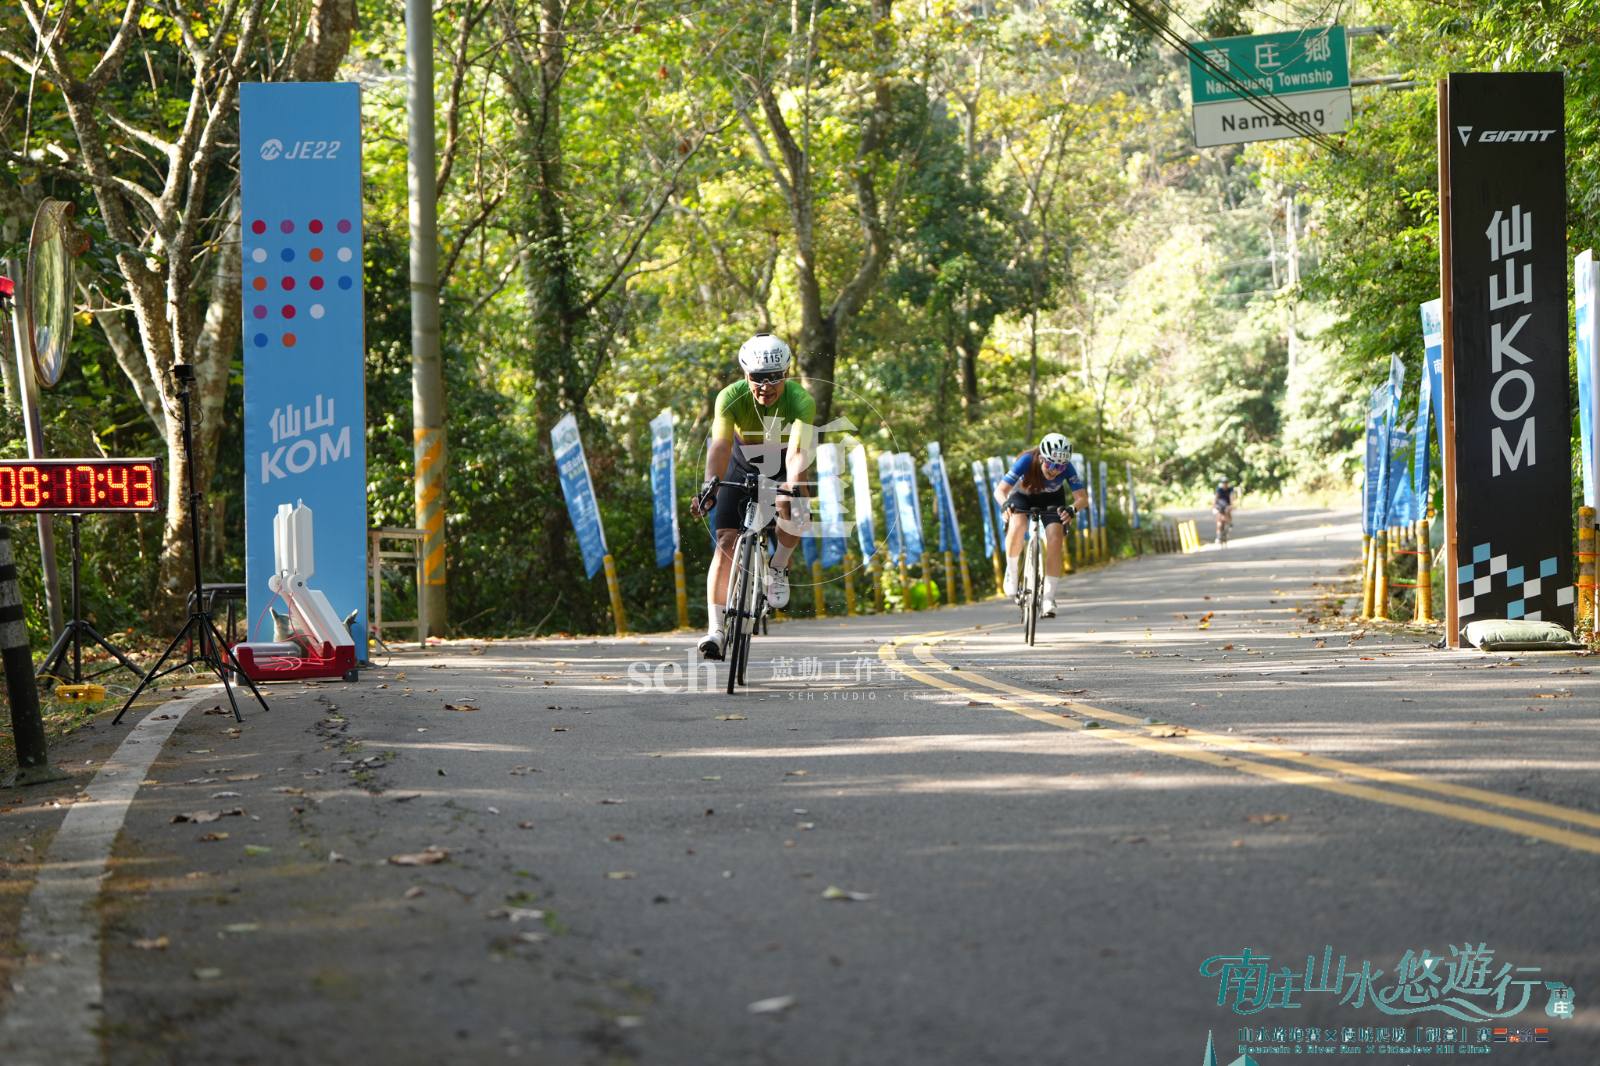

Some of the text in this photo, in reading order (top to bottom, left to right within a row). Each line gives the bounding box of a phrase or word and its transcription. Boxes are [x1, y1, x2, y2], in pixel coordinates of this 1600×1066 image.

[1277, 70, 1333, 87] Township
[1222, 109, 1325, 132] Namzong
[1478, 129, 1557, 143] GIANT
[284, 140, 341, 160] JE22
[268, 393, 335, 444] 仙山
[261, 426, 351, 485] KOM
[0, 465, 154, 507] 08:17:43
